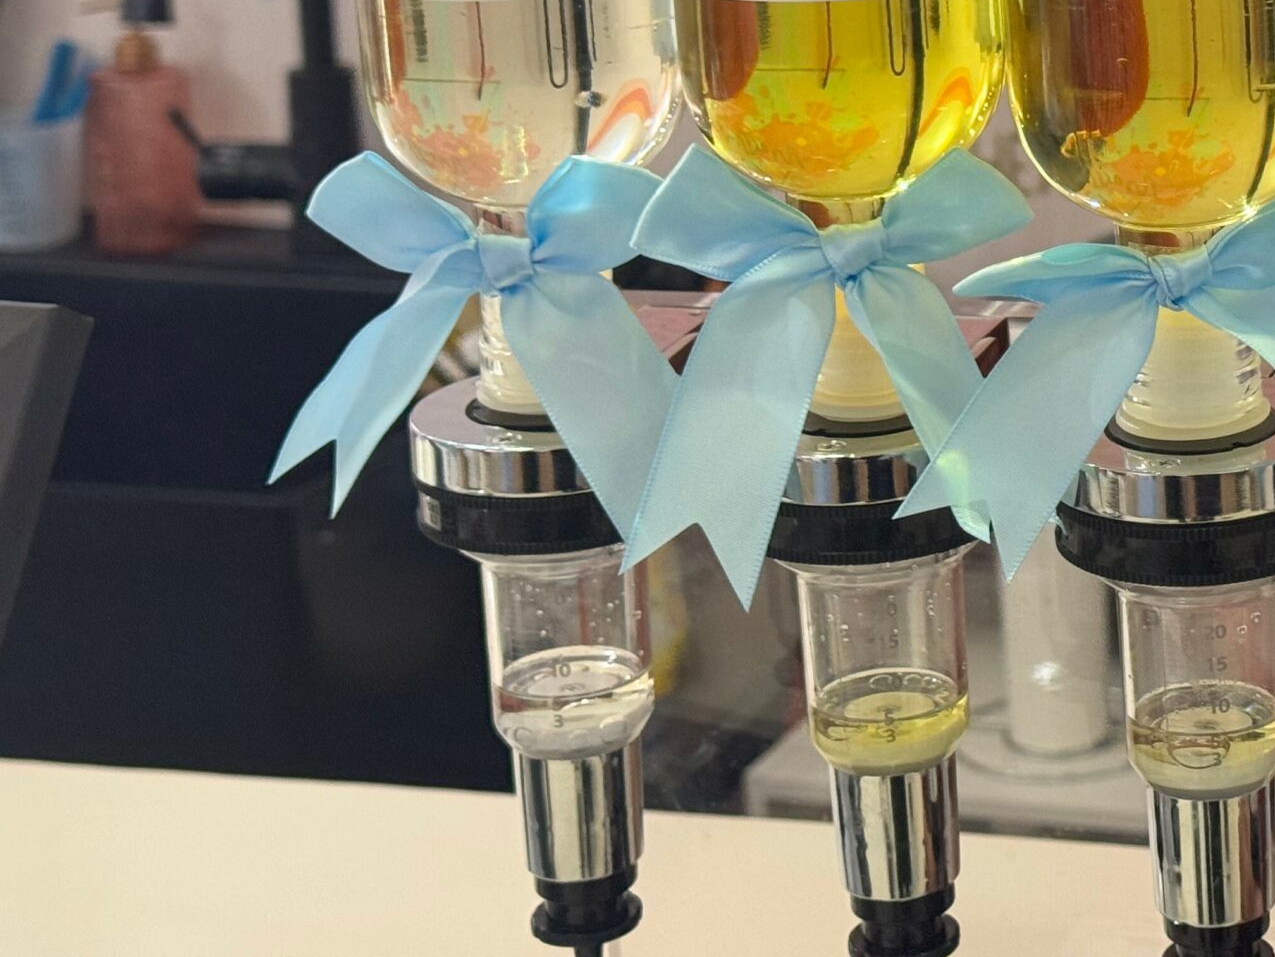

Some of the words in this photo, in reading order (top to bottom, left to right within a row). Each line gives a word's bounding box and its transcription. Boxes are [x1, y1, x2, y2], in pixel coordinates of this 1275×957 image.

[1208, 697, 1231, 714] 10
[553, 714, 565, 728] 3
[885, 728, 896, 743] 3
[1213, 752, 1222, 766] 3
